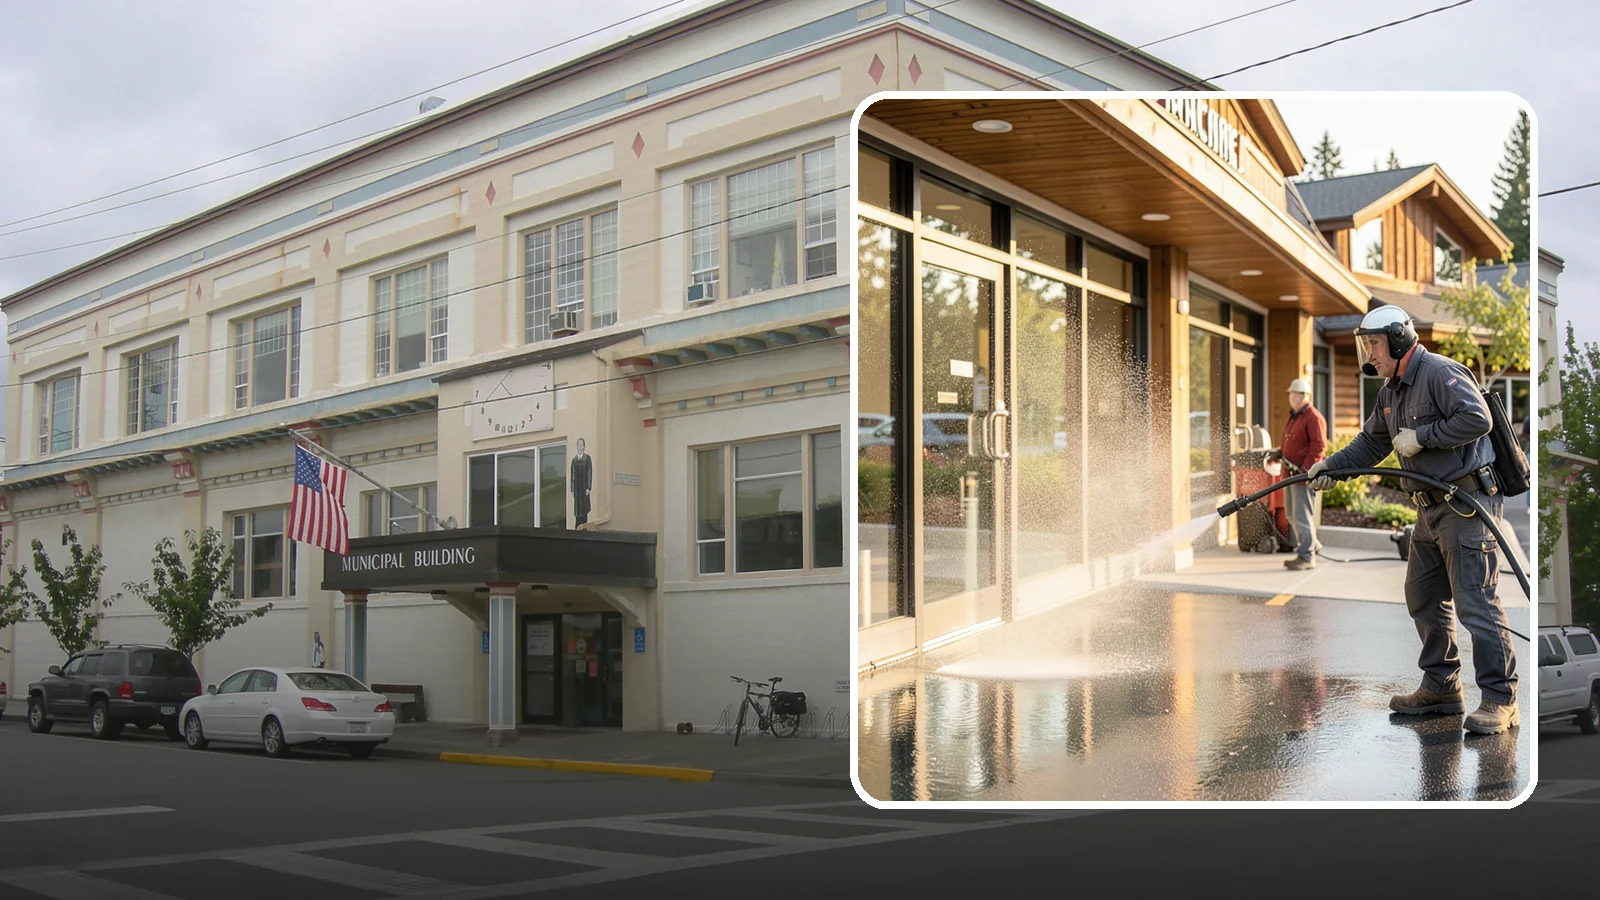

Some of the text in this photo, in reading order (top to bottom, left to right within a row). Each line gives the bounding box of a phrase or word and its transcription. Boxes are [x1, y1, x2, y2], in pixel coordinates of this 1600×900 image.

[481, 407, 485, 415] 8
[488, 418, 492, 426] 9
[529, 414, 533, 422] 3
[495, 424, 500, 432] 10
[521, 420, 525, 428] 2
[508, 425, 513, 433] 12
[342, 546, 475, 572] MUNICIPAL BUILDING
